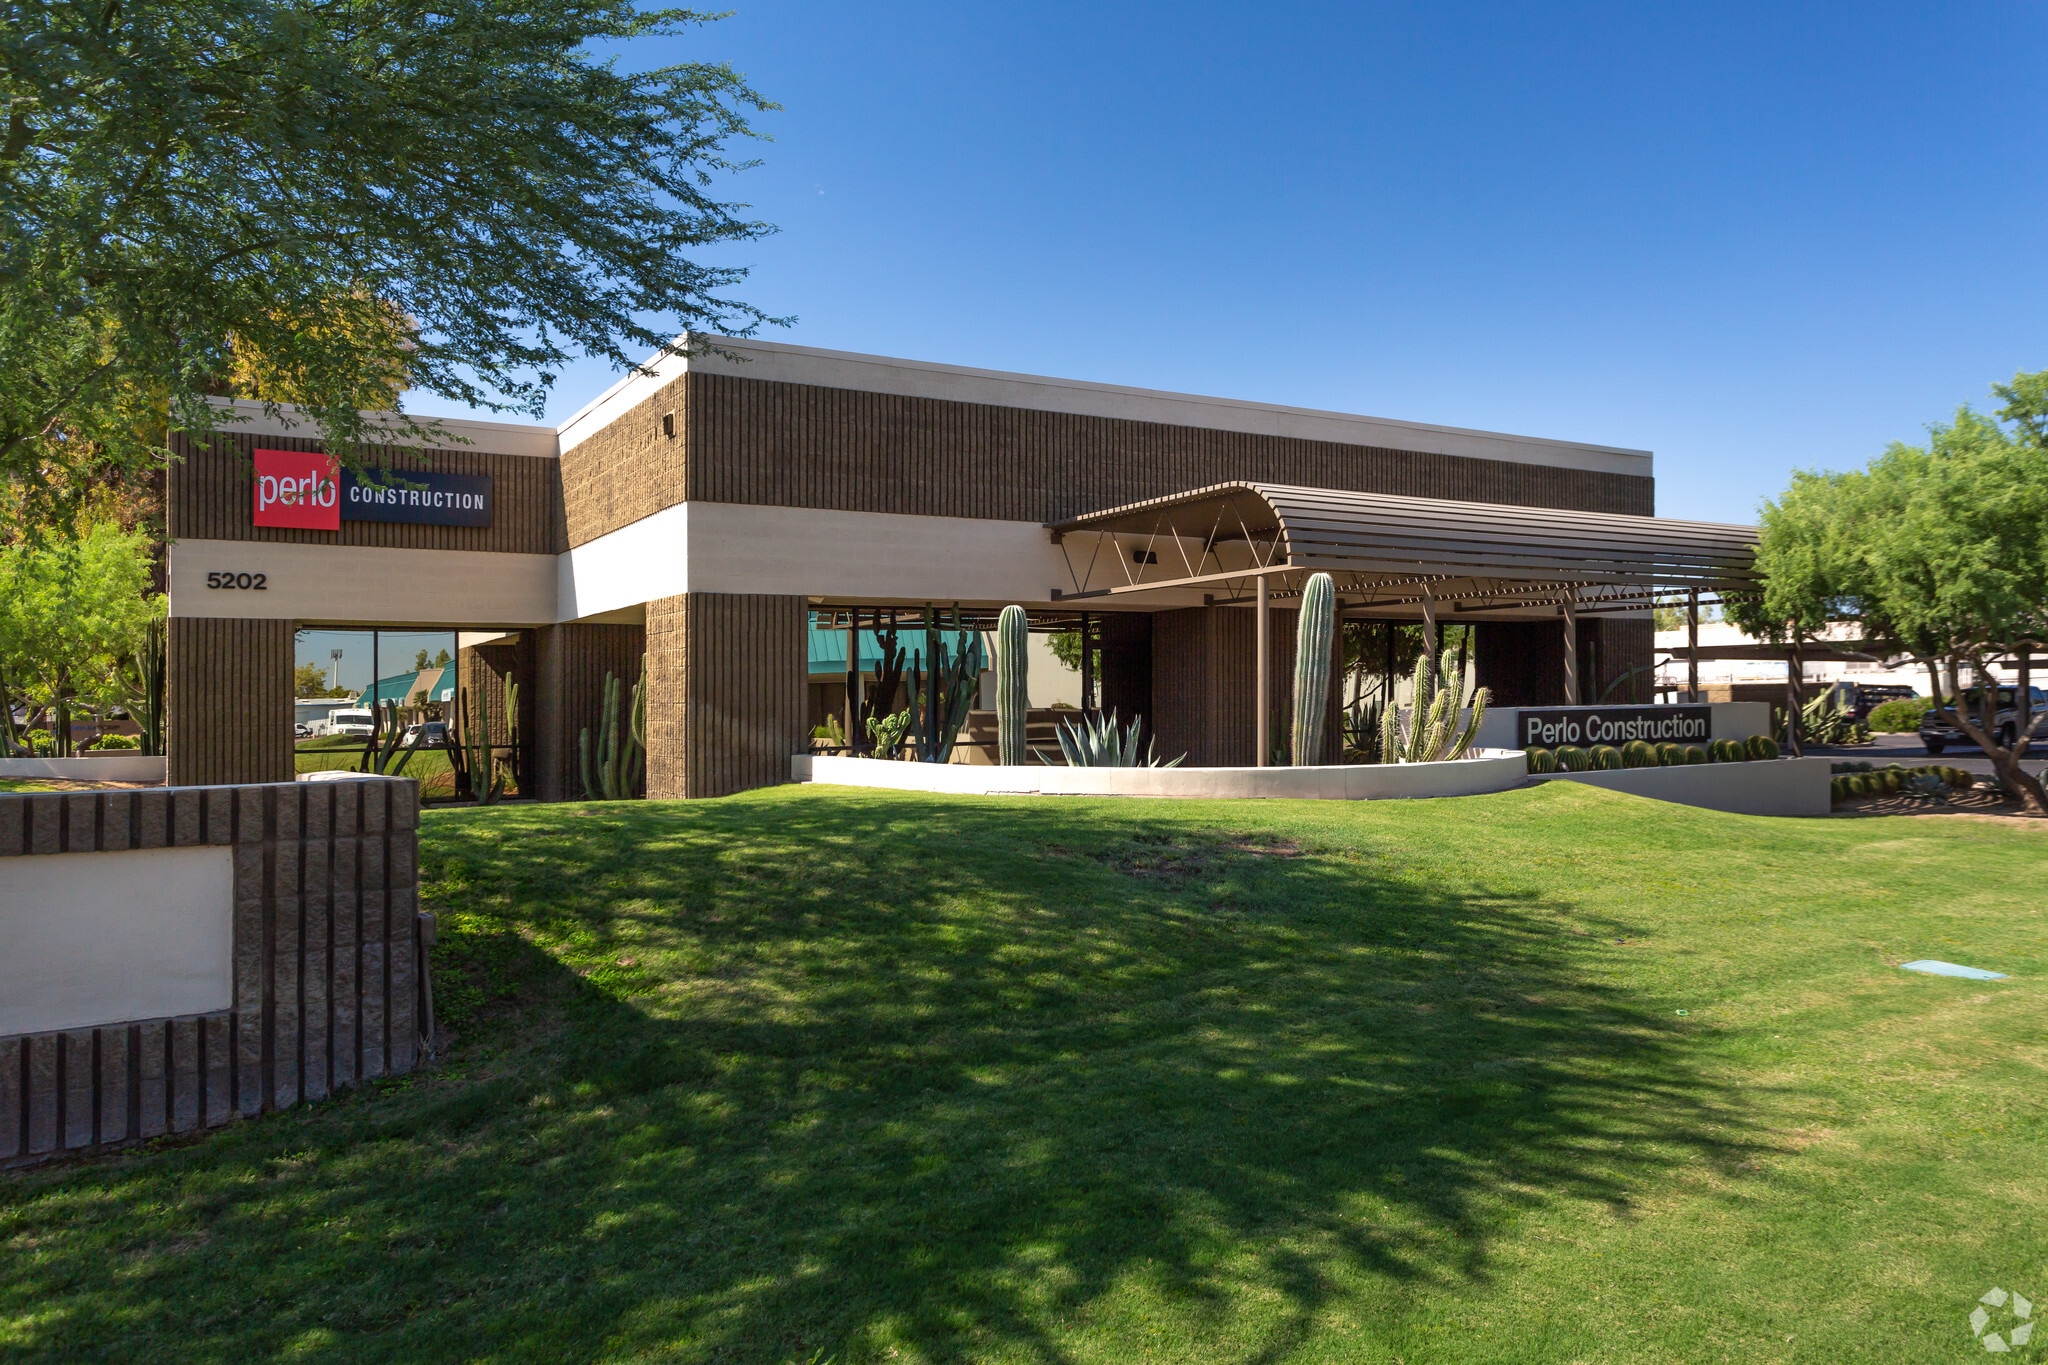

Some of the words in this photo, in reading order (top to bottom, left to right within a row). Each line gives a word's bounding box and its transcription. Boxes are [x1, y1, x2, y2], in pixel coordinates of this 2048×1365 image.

[259, 470, 336, 512] perlo
[350, 486, 484, 510] CONSTRUCTION
[207, 572, 268, 590] 5202
[1527, 716, 1580, 745] Perlo
[1585, 713, 1706, 742] Construction
